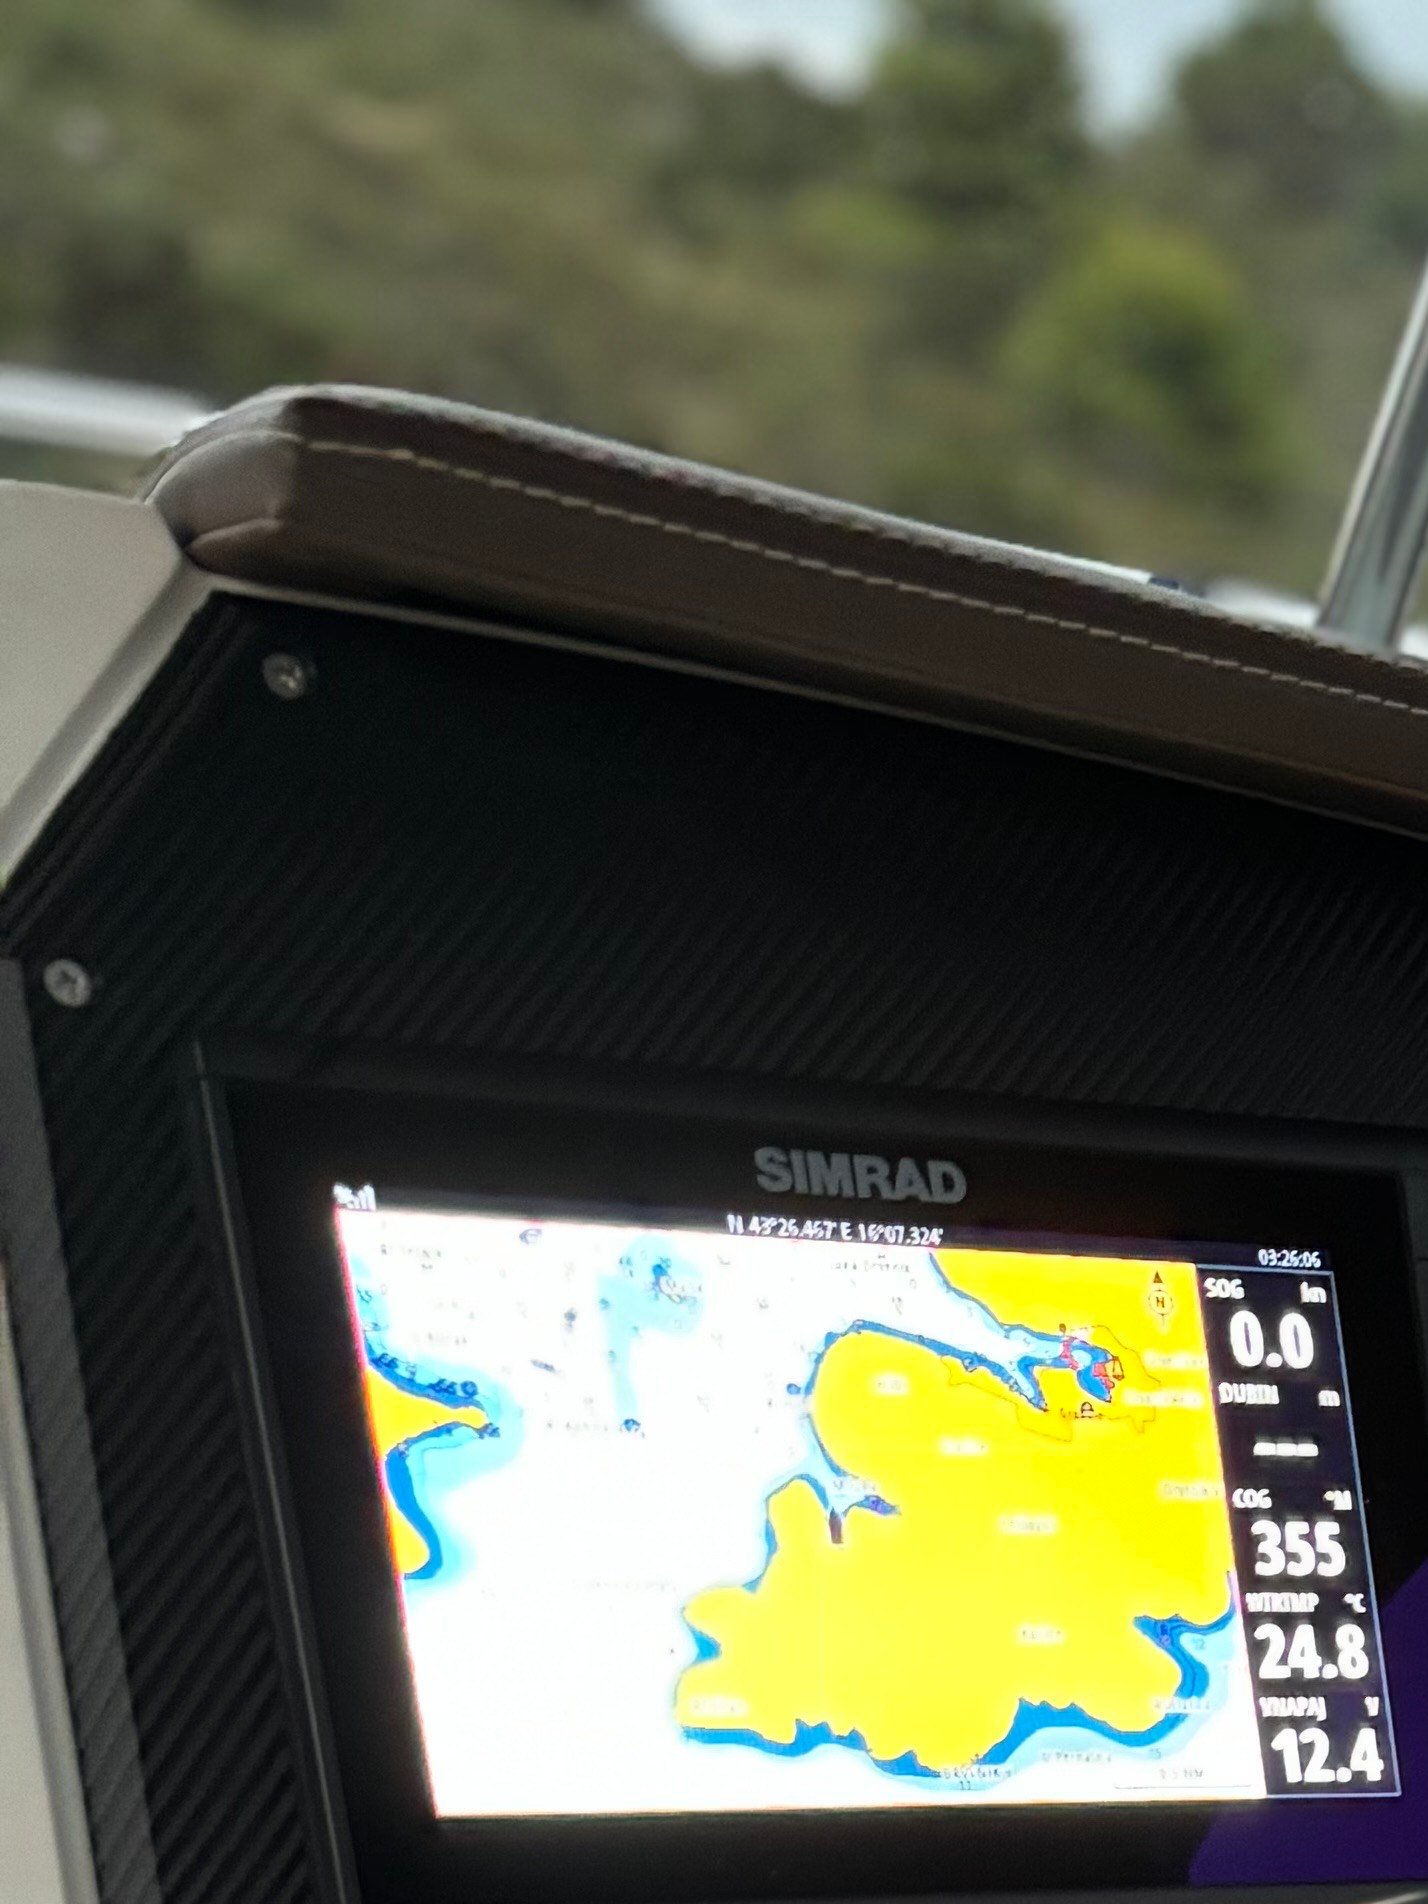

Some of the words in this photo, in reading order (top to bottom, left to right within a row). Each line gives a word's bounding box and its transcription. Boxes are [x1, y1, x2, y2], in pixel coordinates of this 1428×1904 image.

[754, 1146, 967, 1203] SIMRAD
[727, 1213, 744, 1234] N
[840, 1221, 852, 1241] E
[1204, 1277, 1245, 1299] SOG
[1230, 1310, 1314, 1369] 0.0
[1232, 1488, 1272, 1509] COG
[1251, 1519, 1346, 1577] 355
[1344, 1593, 1366, 1613] °C
[1254, 1623, 1369, 1679] 24.8
[1271, 1727, 1384, 1783] 12.4
